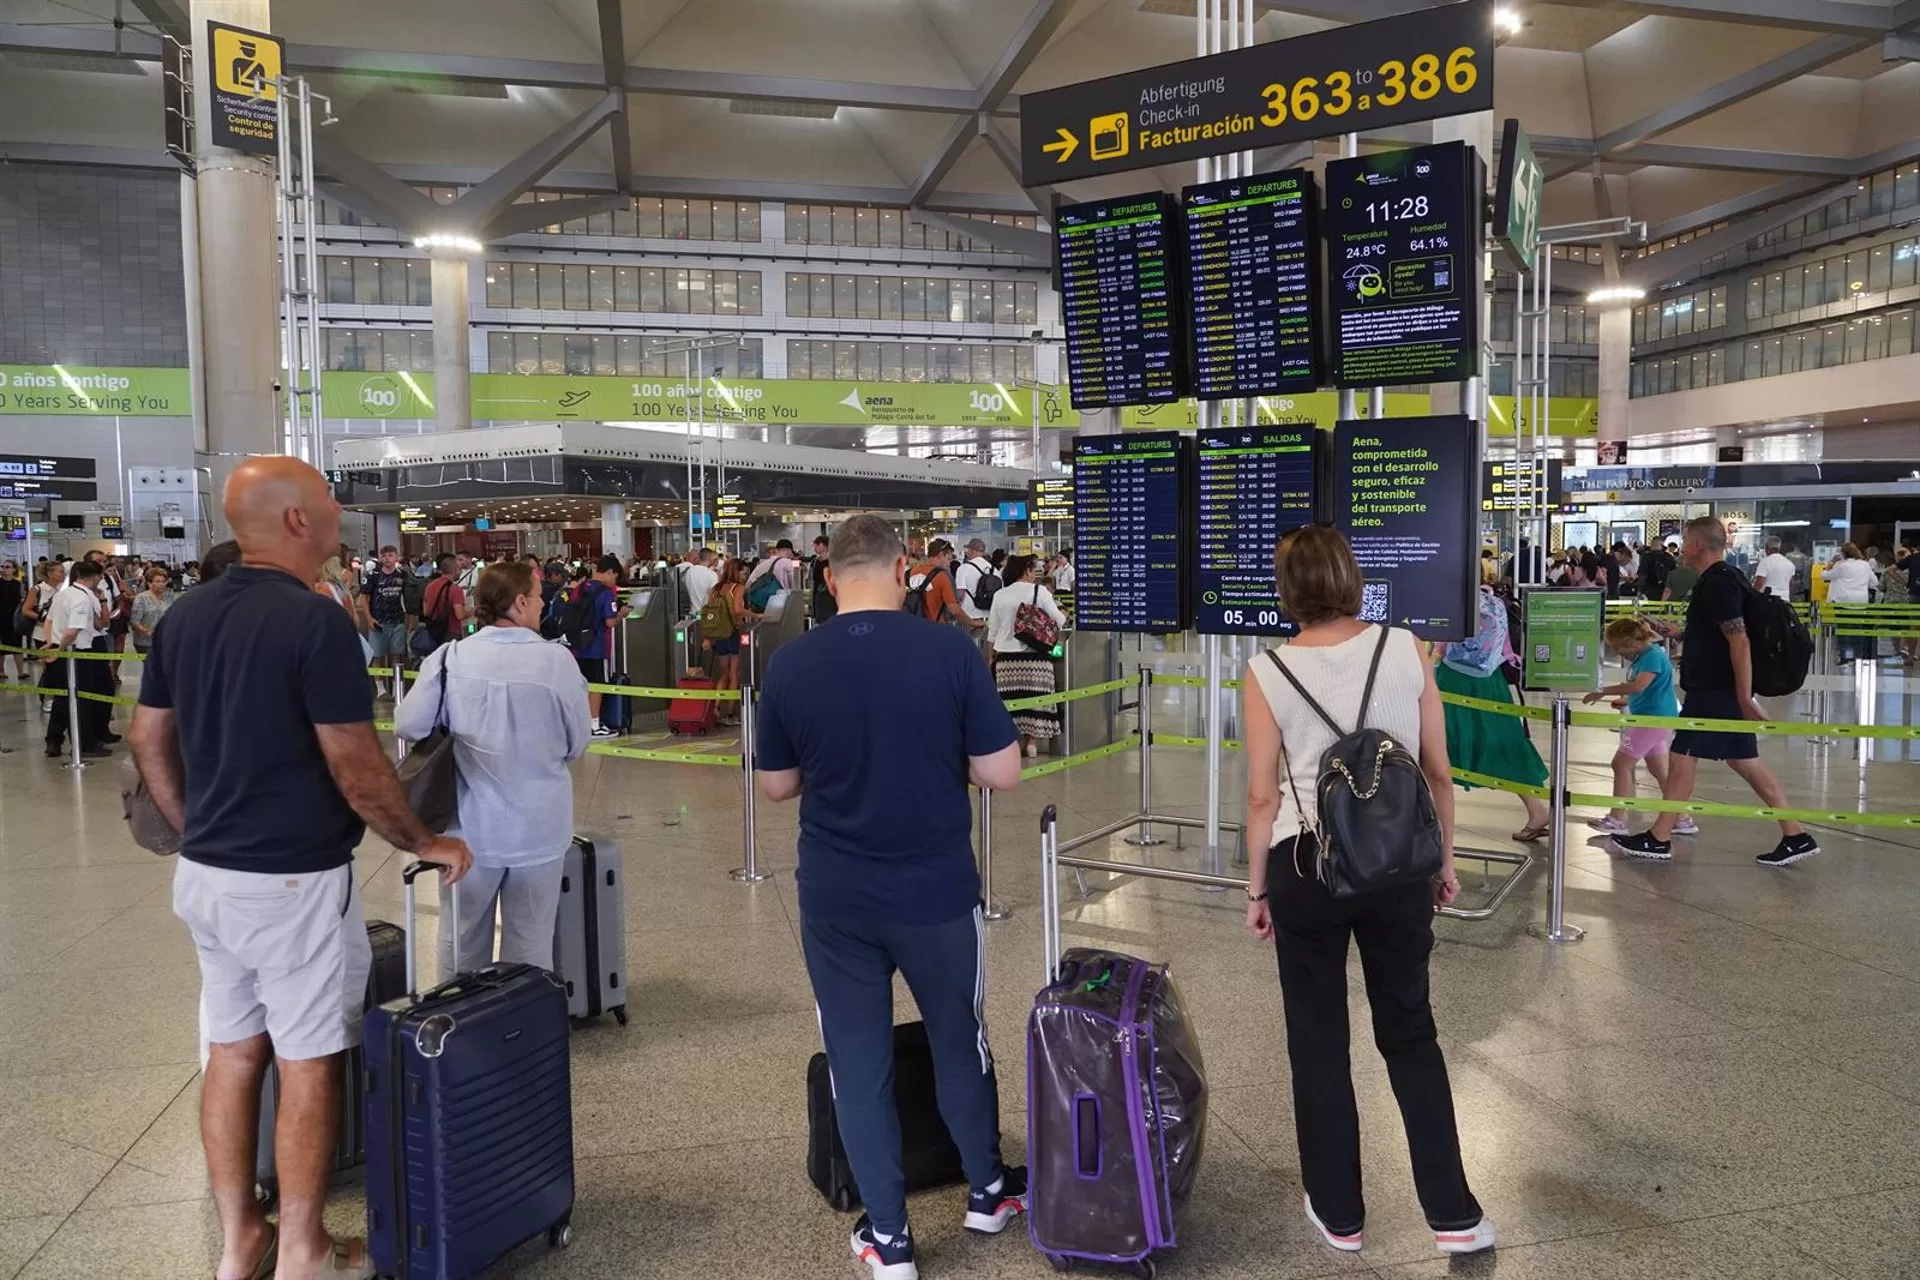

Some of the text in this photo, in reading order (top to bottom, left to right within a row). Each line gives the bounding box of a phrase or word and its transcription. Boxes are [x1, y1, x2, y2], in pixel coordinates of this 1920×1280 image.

[1356, 66, 1373, 85] to
[1139, 74, 1226, 106] Abfertigung
[1139, 46, 1479, 151] Facturación 363 a 386
[224, 105, 252, 118] Security
[1139, 101, 1201, 126] Check-in
[228, 115, 274, 130] Control de
[229, 125, 274, 139] seguridad
[1247, 180, 1297, 195] DEPARTURES
[1112, 202, 1157, 216] DEPARTURES
[1366, 195, 1429, 223] 11:28
[1410, 222, 1447, 234] Humedad
[1342, 230, 1388, 242] Temperatura
[13, 373, 56, 387] años
[364, 387, 395, 406] 100
[631, 383, 662, 397] 100
[14, 394, 61, 408] Years
[68, 394, 132, 412] Serving
[137, 395, 169, 409] You
[865, 396, 894, 406] aena
[969, 390, 1004, 412] 100
[632, 402, 661, 416] 100
[772, 404, 798, 418] You
[871, 406, 906, 415] Aeropuerto
[1128, 441, 1172, 450] DEPARTURES
[1263, 434, 1302, 444] SALIDAS
[1352, 437, 1382, 447] Aena,
[1352, 448, 1428, 461] comprometida
[1352, 461, 1439, 474] con el desarrollo
[1352, 476, 1425, 488] seguro, eficaz
[1580, 478, 1707, 489] THE FASHION GALLERY
[1352, 489, 1416, 502] y sostenible
[1608, 492, 1616, 500] 4
[1352, 503, 1427, 515] del transporte
[1723, 511, 1748, 519] BOSS
[102, 517, 120, 526] 362
[1352, 516, 1384, 527] aéreo.
[1224, 610, 1243, 625] 05
[1259, 611, 1278, 625] 00
